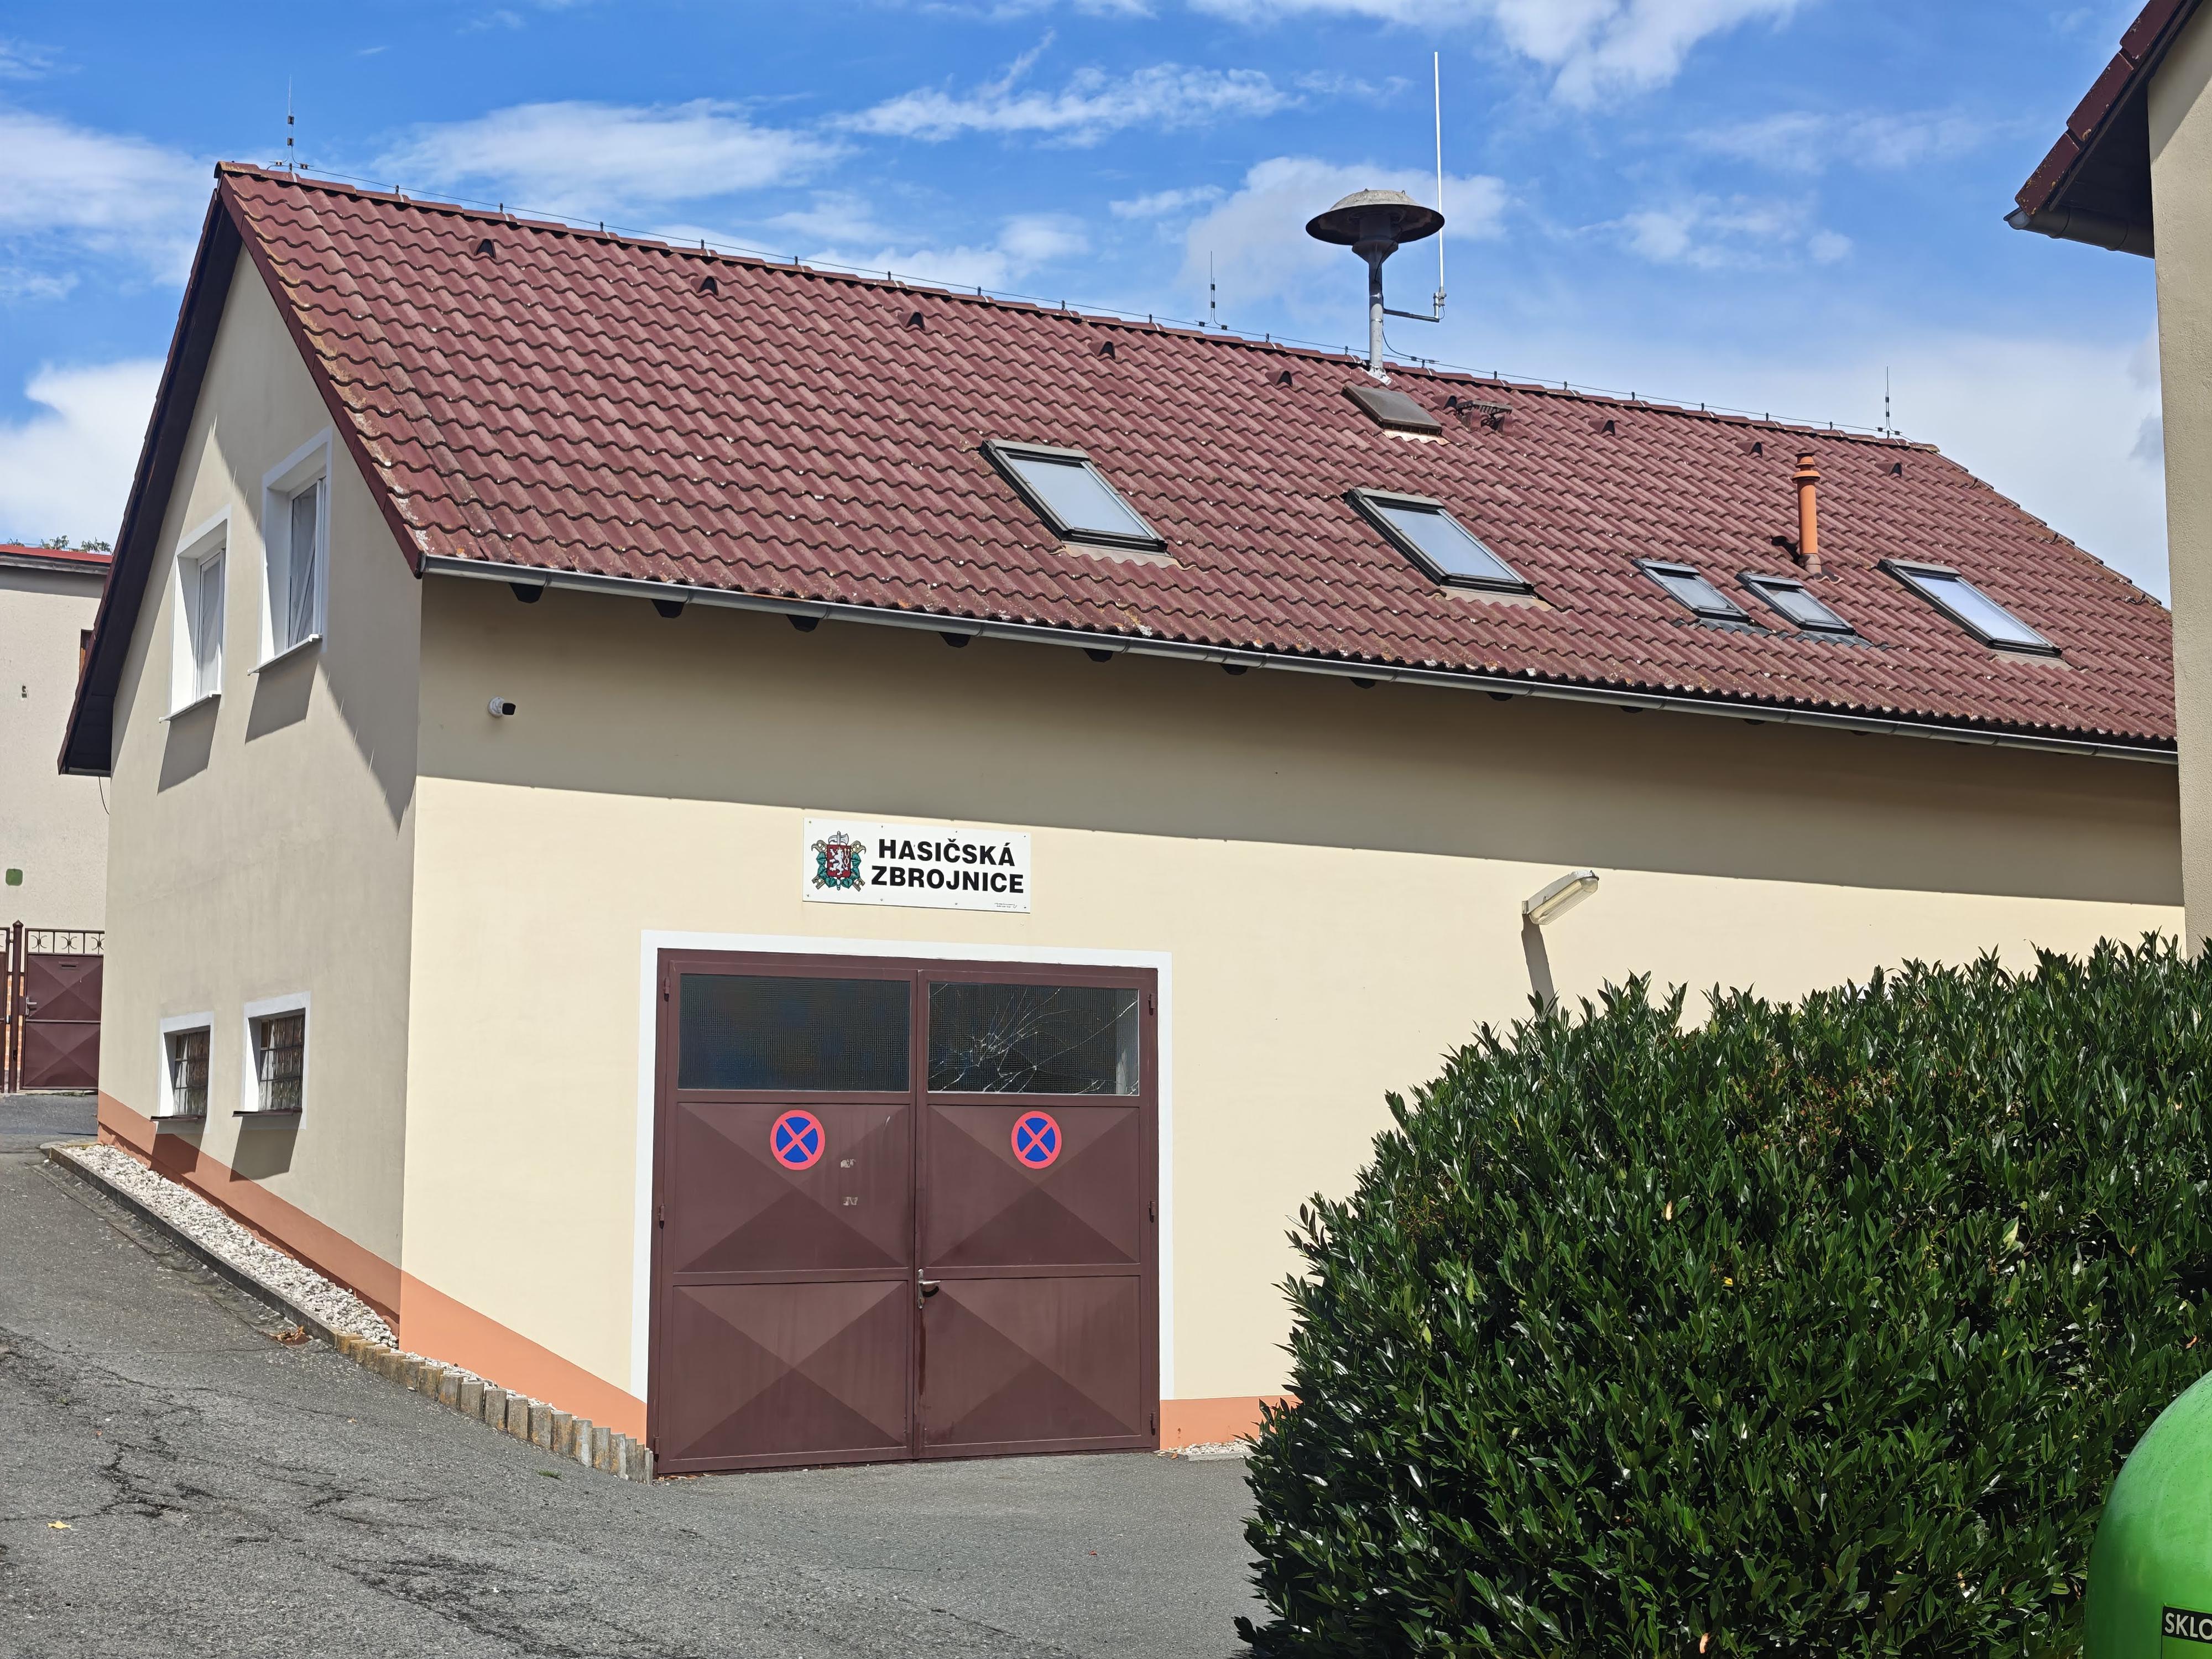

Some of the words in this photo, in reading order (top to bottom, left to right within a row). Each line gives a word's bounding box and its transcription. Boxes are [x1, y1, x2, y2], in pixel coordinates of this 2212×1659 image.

[879, 838, 1015, 867] HASIČSKÁ
[871, 865, 1024, 894] ZBROJNICE
[2164, 1612, 2212, 1640] SKLO
